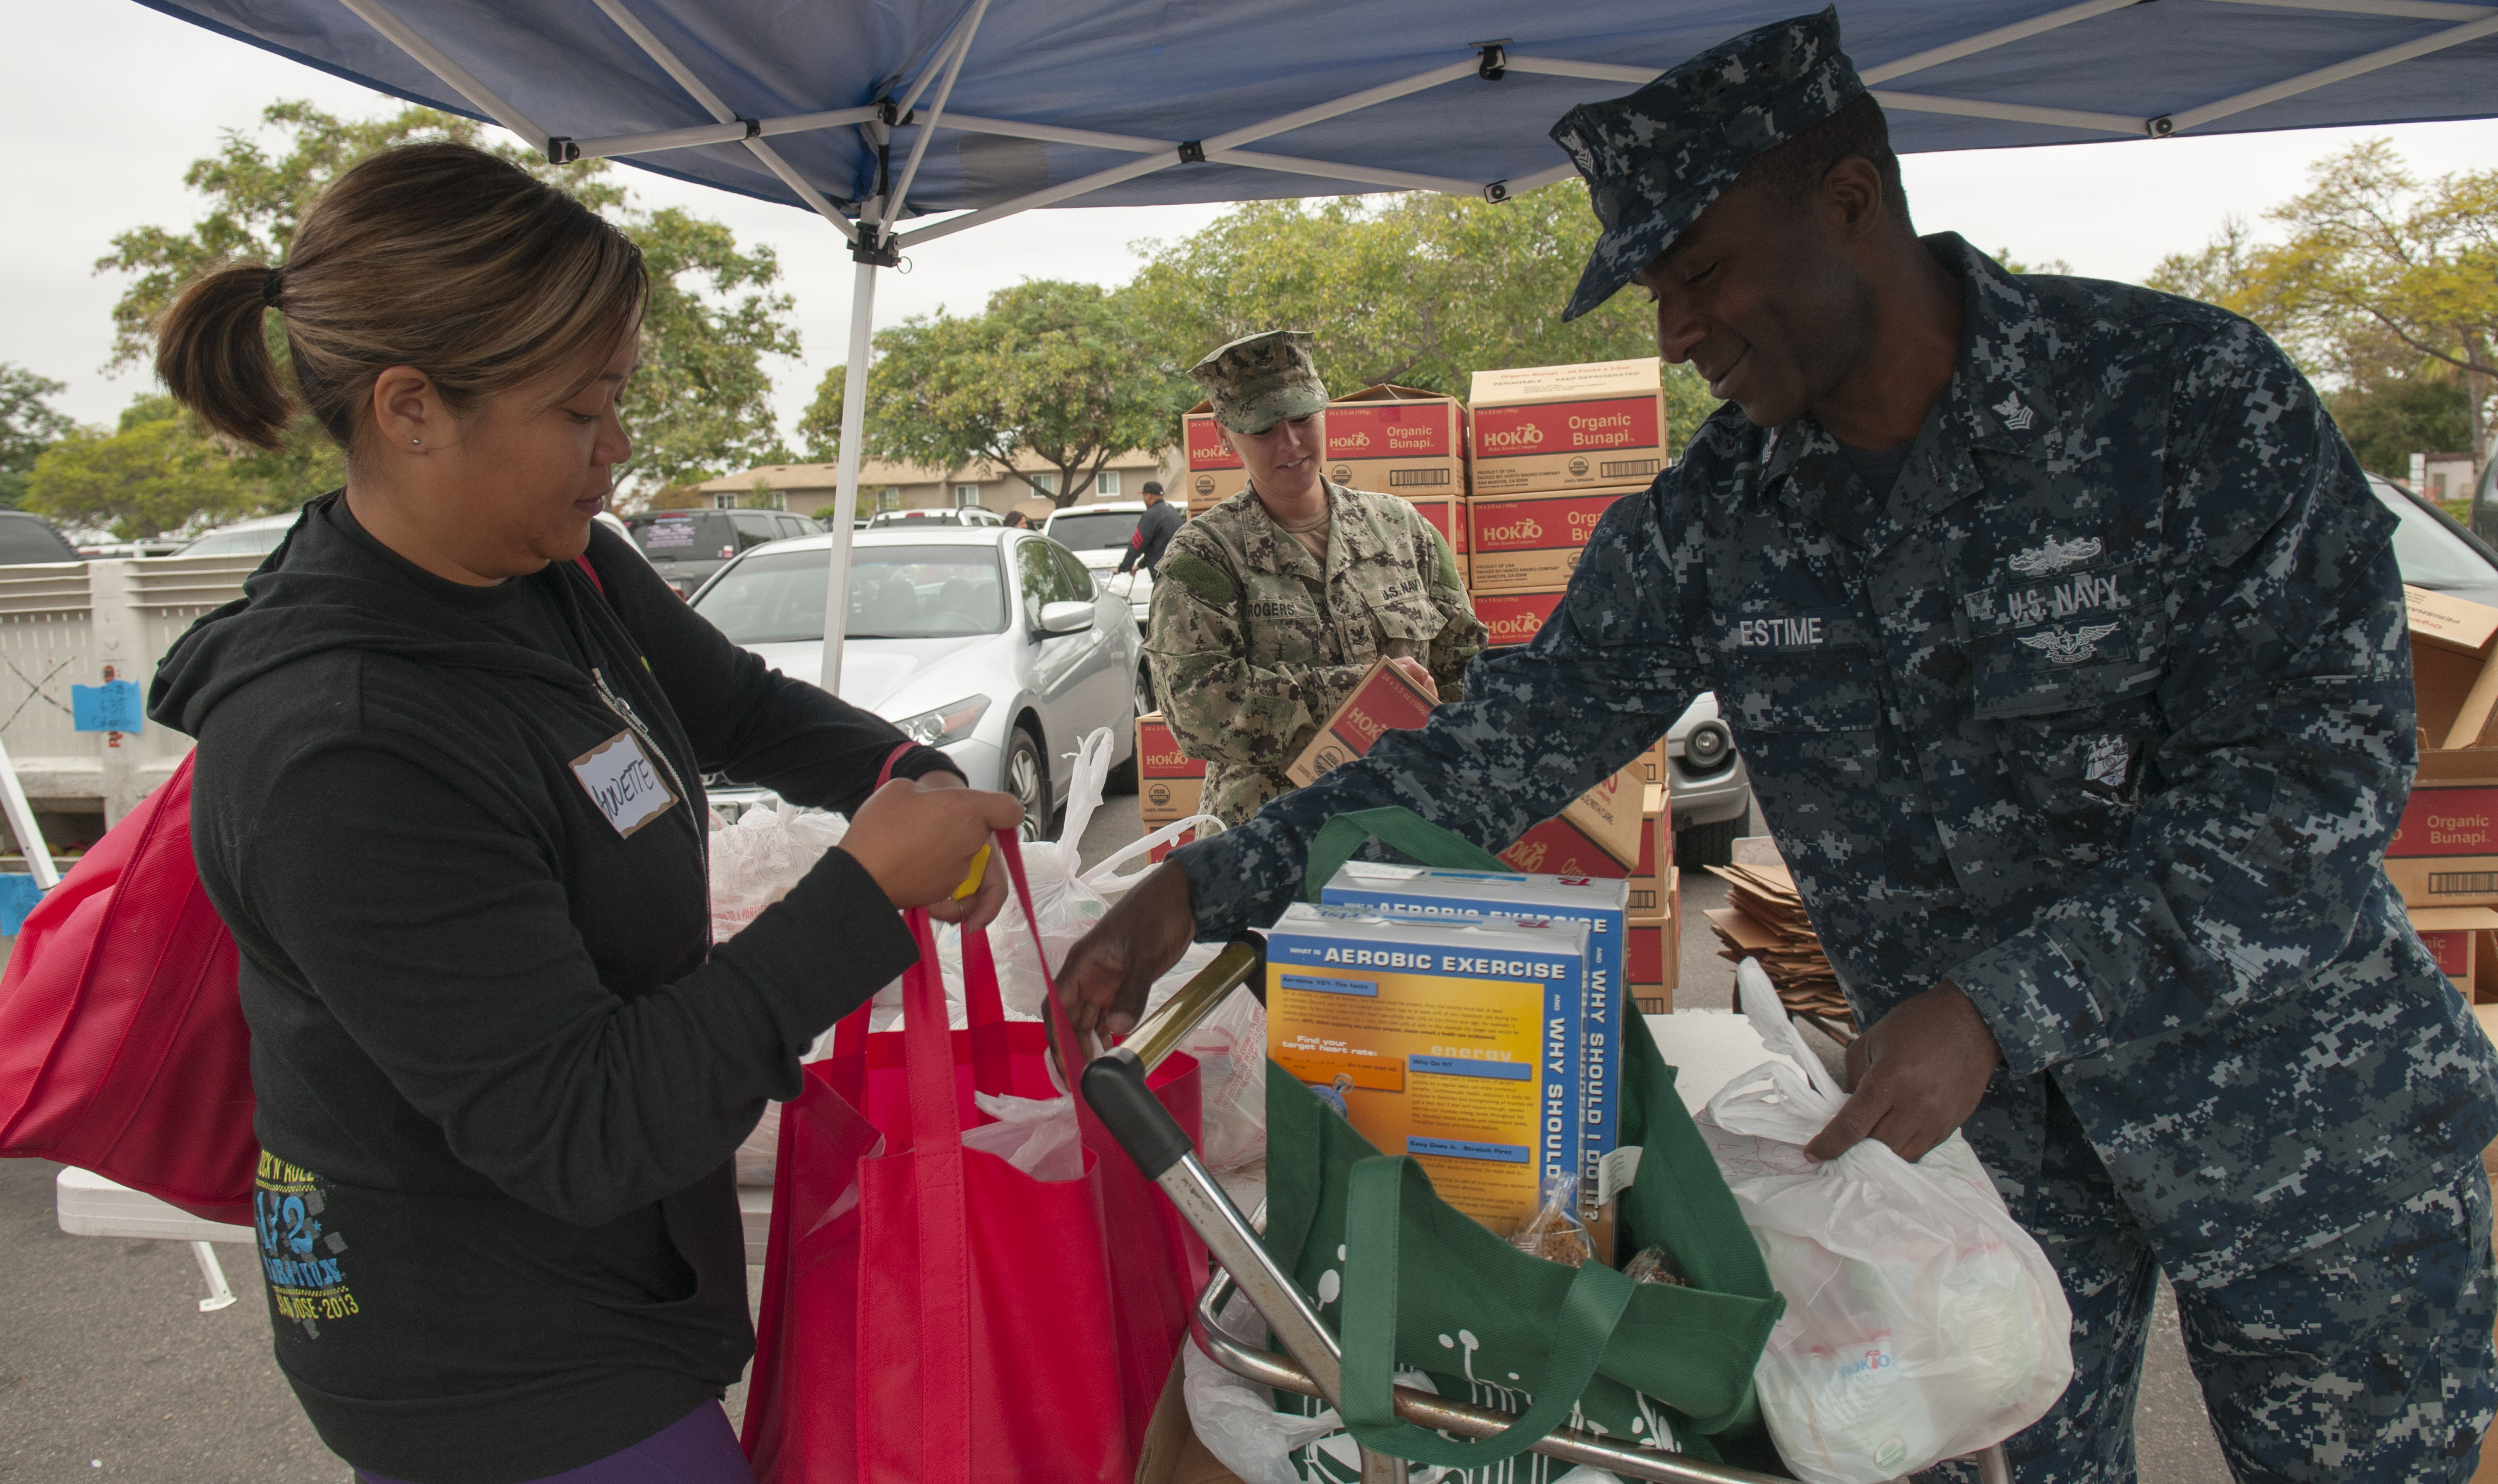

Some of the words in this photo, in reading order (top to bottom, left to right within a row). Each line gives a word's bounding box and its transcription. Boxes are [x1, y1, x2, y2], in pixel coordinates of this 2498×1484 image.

[1387, 425, 1432, 438] Organic
[1568, 413, 1631, 431] Organic
[1329, 432, 1370, 448] HOKTO
[1390, 438, 1430, 450] Bunapi
[1485, 423, 1544, 447] HOKTO
[1572, 430, 1628, 448] Bunapi
[1483, 518, 1542, 541] HOKTO
[1382, 585, 1400, 600] U.S.
[1401, 578, 1422, 595] NAVY
[2008, 589, 2047, 620] U.S.
[2054, 575, 2118, 612] NAVY
[1248, 603, 1295, 616] ROGERS
[2408, 606, 2460, 624] PERISHA
[1488, 612, 1543, 634] HOKTO
[1740, 617, 1823, 646] ESTIME
[1348, 707, 1387, 741] HOK
[1146, 750, 1188, 765] HOKTO
[1289, 947, 1313, 956] WHAT
[1324, 947, 1432, 970] AEROBIC
[1442, 956, 1566, 980] EXERCISE
[1590, 970, 1606, 1023] WHY
[1282, 1041, 1316, 1050] target
[1319, 1045, 1348, 1053] heart
[1297, 1035, 1320, 1044] Find
[1549, 1018, 1565, 1074] WHY
[1431, 1045, 1513, 1062] energy
[1588, 1033, 1604, 1125] SHOULD
[1546, 1084, 1563, 1180] SHOULD
[1585, 1150, 1601, 1180] DO
[1584, 1190, 1599, 1221] IT?
[276, 1293, 294, 1318] SAN
[292, 1296, 319, 1320] JOSE
[322, 1293, 360, 1320] 2013
